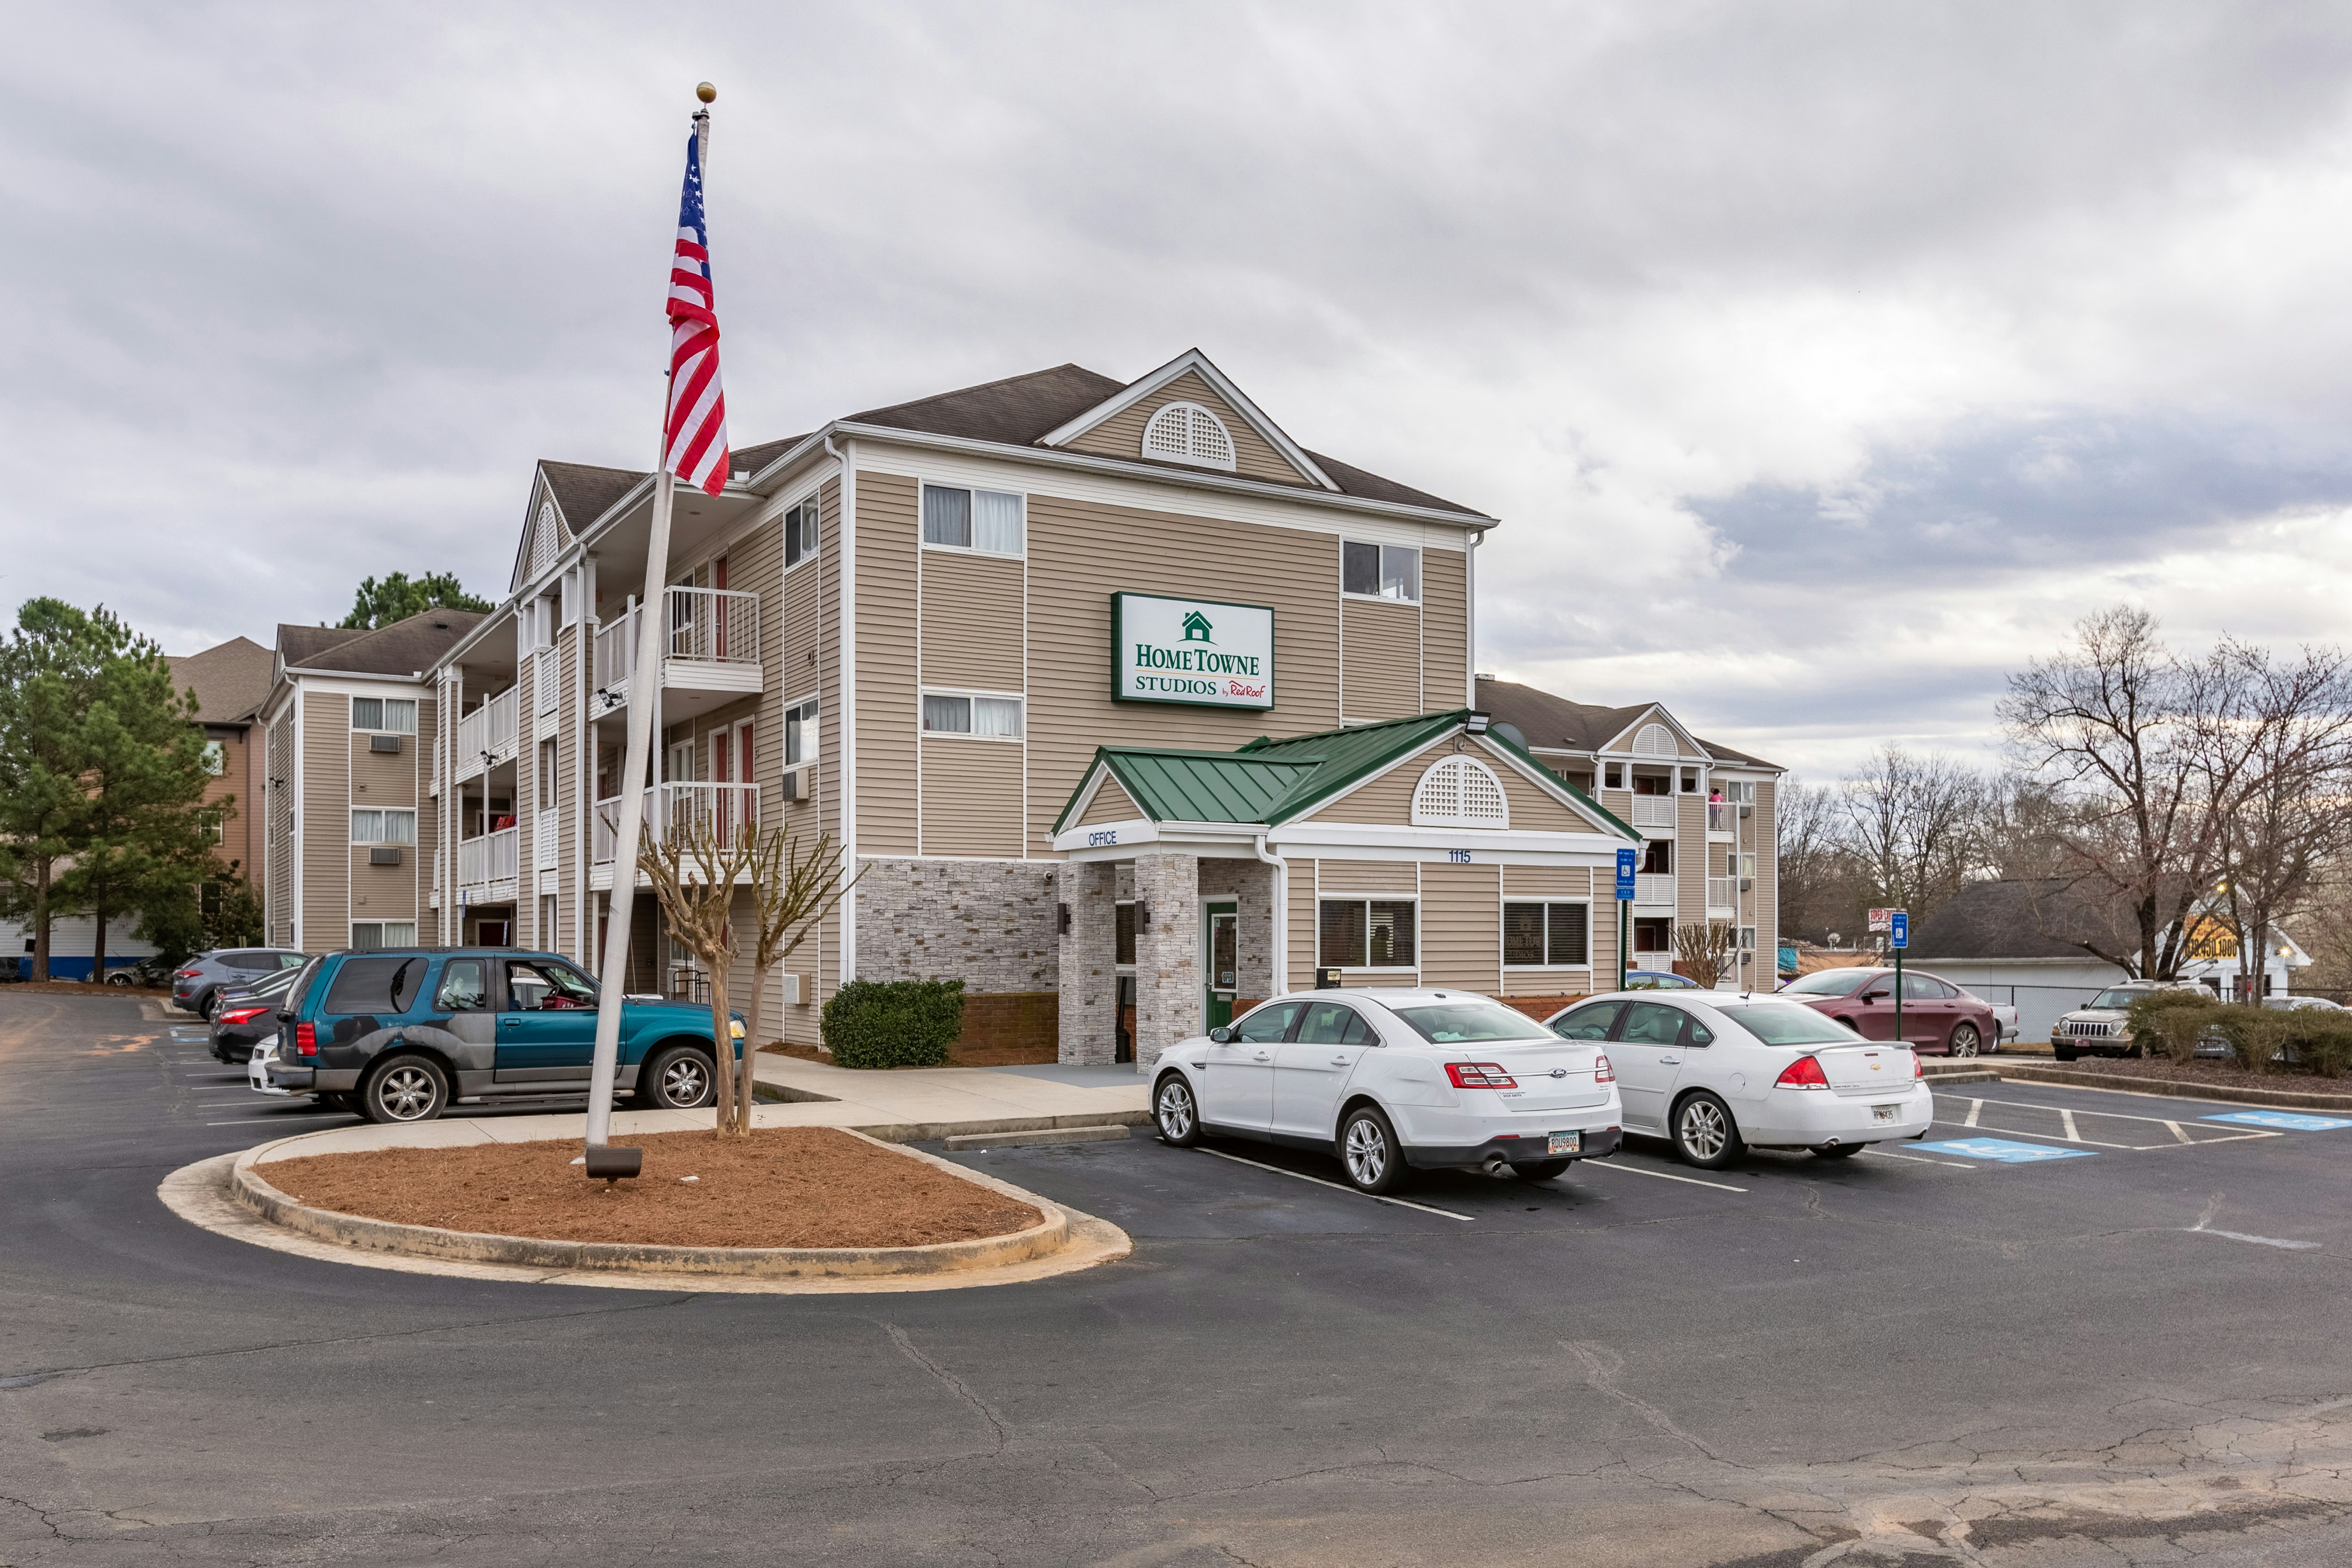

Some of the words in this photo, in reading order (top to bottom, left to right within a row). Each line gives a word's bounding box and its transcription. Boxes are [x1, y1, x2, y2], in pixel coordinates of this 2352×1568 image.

[1136, 676, 1217, 695] STUDIOS
[1222, 688, 1228, 697] by
[1089, 831, 1117, 846] OFFICE
[1449, 850, 1471, 863] 1115
[1871, 909, 1883, 920] SUPER
[1223, 972, 1233, 982] OPEN
[1552, 1137, 1576, 1148] RDU9800
